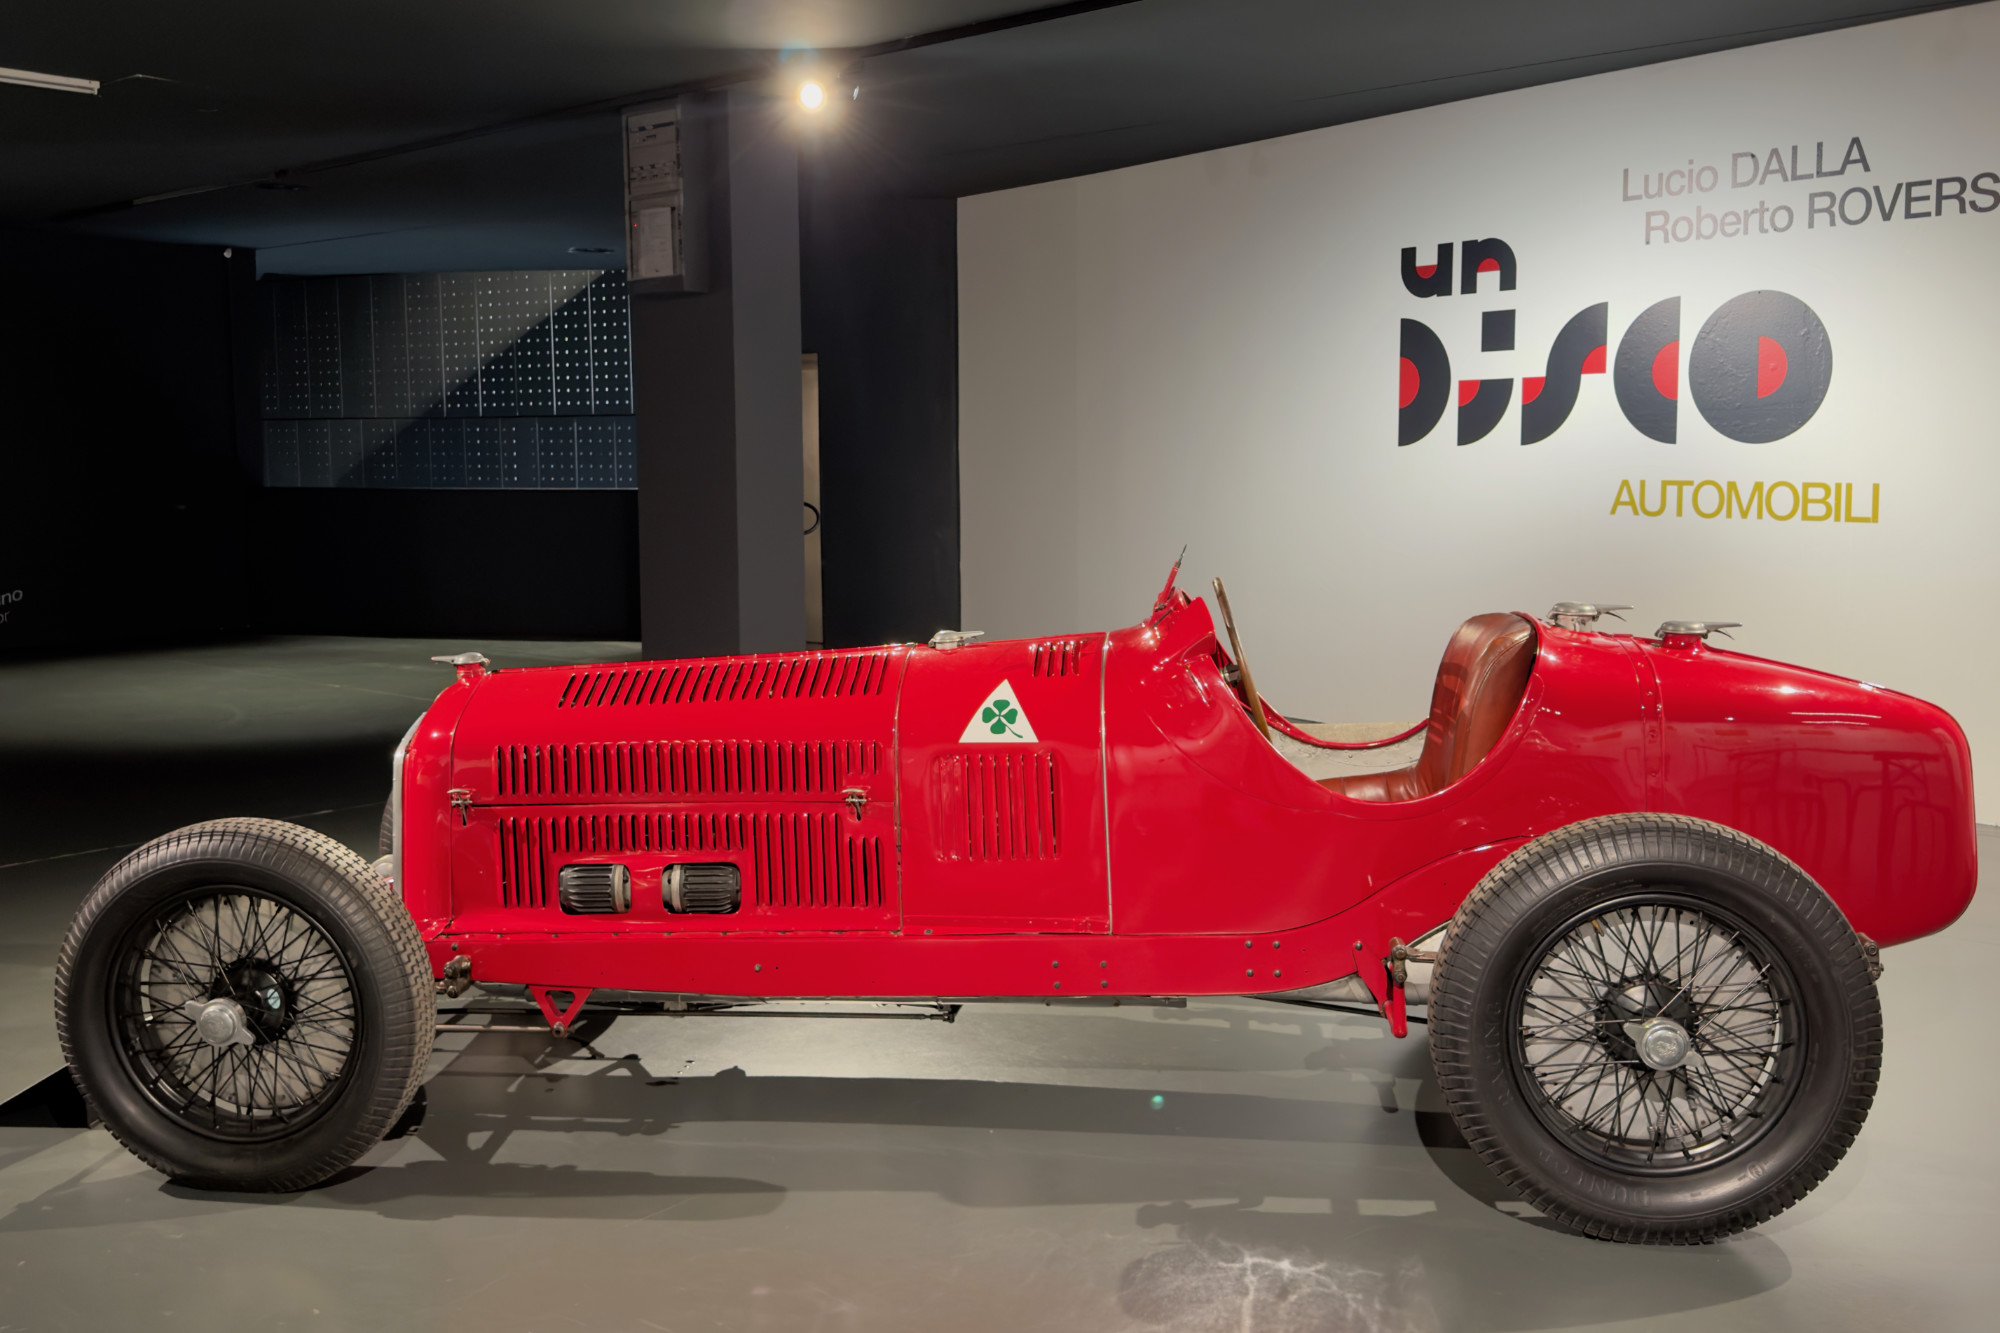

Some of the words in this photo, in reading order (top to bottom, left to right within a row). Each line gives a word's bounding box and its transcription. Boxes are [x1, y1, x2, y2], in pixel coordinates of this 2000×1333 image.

[1622, 159, 1719, 202] Lucio
[1731, 136, 1871, 189] DALLA
[1645, 200, 1794, 245] Roberto
[1807, 172, 2000, 229] ROVERS
[1401, 237, 1517, 298] un
[1610, 479, 1880, 523] AUTOMOBILI
[0, 589, 23, 607] no
